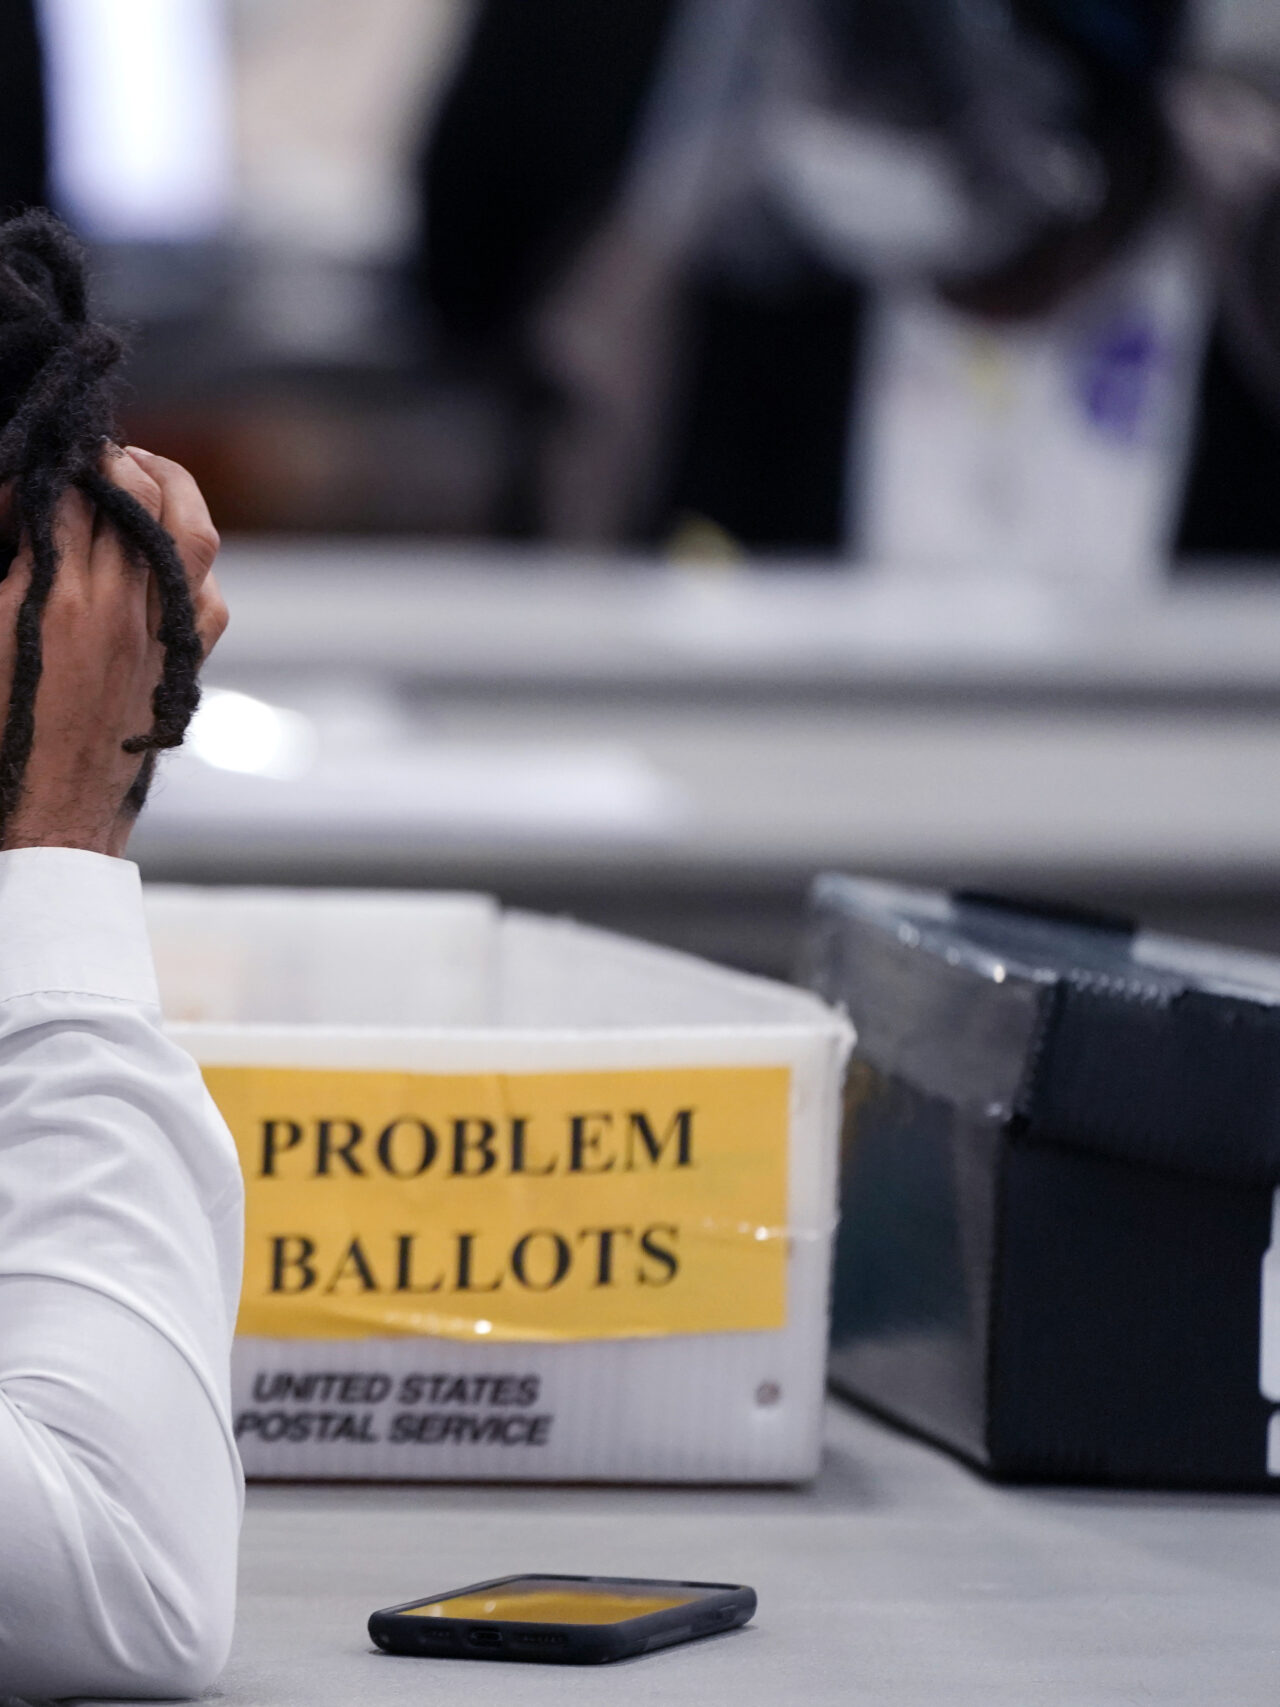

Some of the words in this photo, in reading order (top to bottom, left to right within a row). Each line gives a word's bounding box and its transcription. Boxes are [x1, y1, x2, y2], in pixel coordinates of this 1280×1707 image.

[258, 1106, 697, 1178] PROBLEM
[267, 1223, 683, 1295] BALLOTS
[252, 1372, 393, 1405] UNITED
[399, 1373, 541, 1407] STATES
[235, 1411, 378, 1443] POSTAL
[387, 1412, 555, 1446] SERVICE
